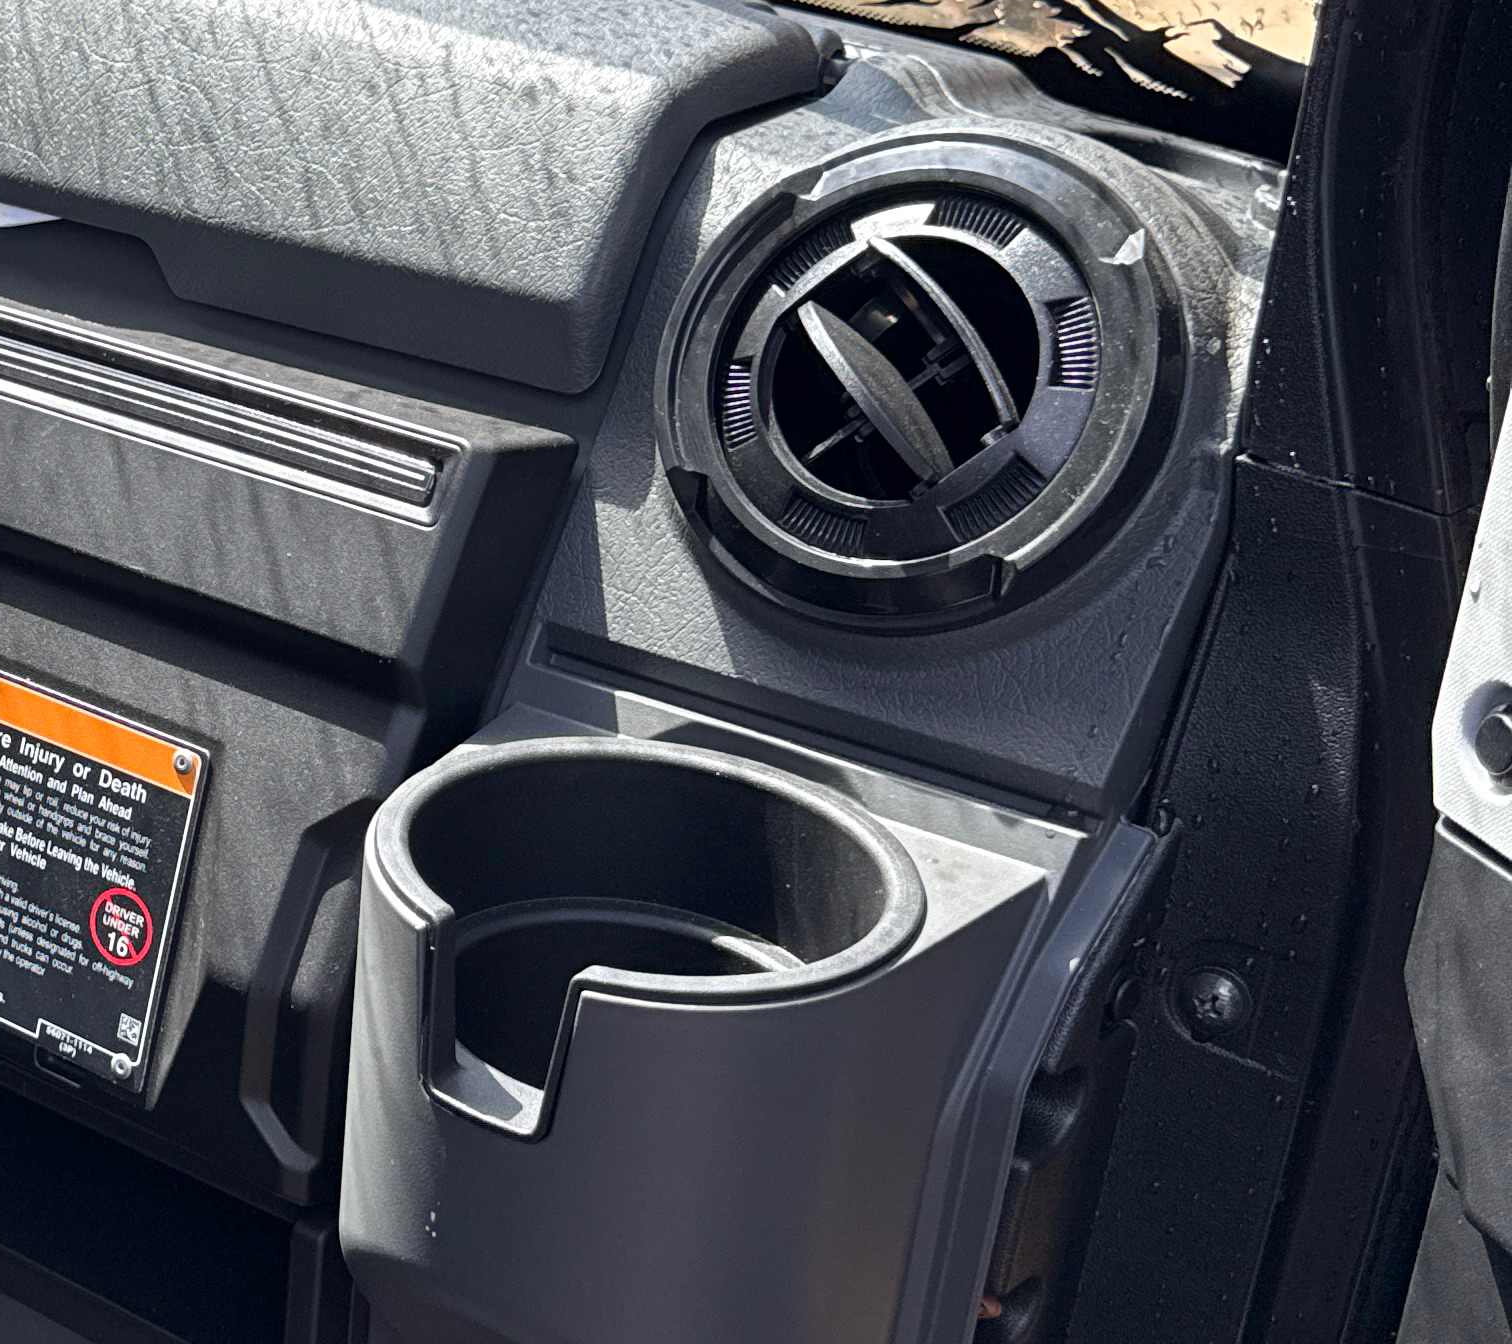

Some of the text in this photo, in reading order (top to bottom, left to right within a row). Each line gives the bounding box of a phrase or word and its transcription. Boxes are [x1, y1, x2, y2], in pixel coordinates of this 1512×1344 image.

[19, 737, 65, 773] Injury
[72, 762, 91, 780] or
[98, 769, 147, 803] Death
[46, 777, 68, 794] and
[70, 784, 95, 805] Plan
[98, 796, 133, 821] Ahead
[10, 842, 47, 870] Vehicle
[15, 827, 46, 852] Before
[46, 840, 83, 871] Leaving
[83, 856, 100, 875] the
[101, 863, 136, 891] Vehicle.
[102, 914, 140, 939] UNDER
[105, 900, 145, 928] DRIVER
[104, 931, 131, 957] 16
